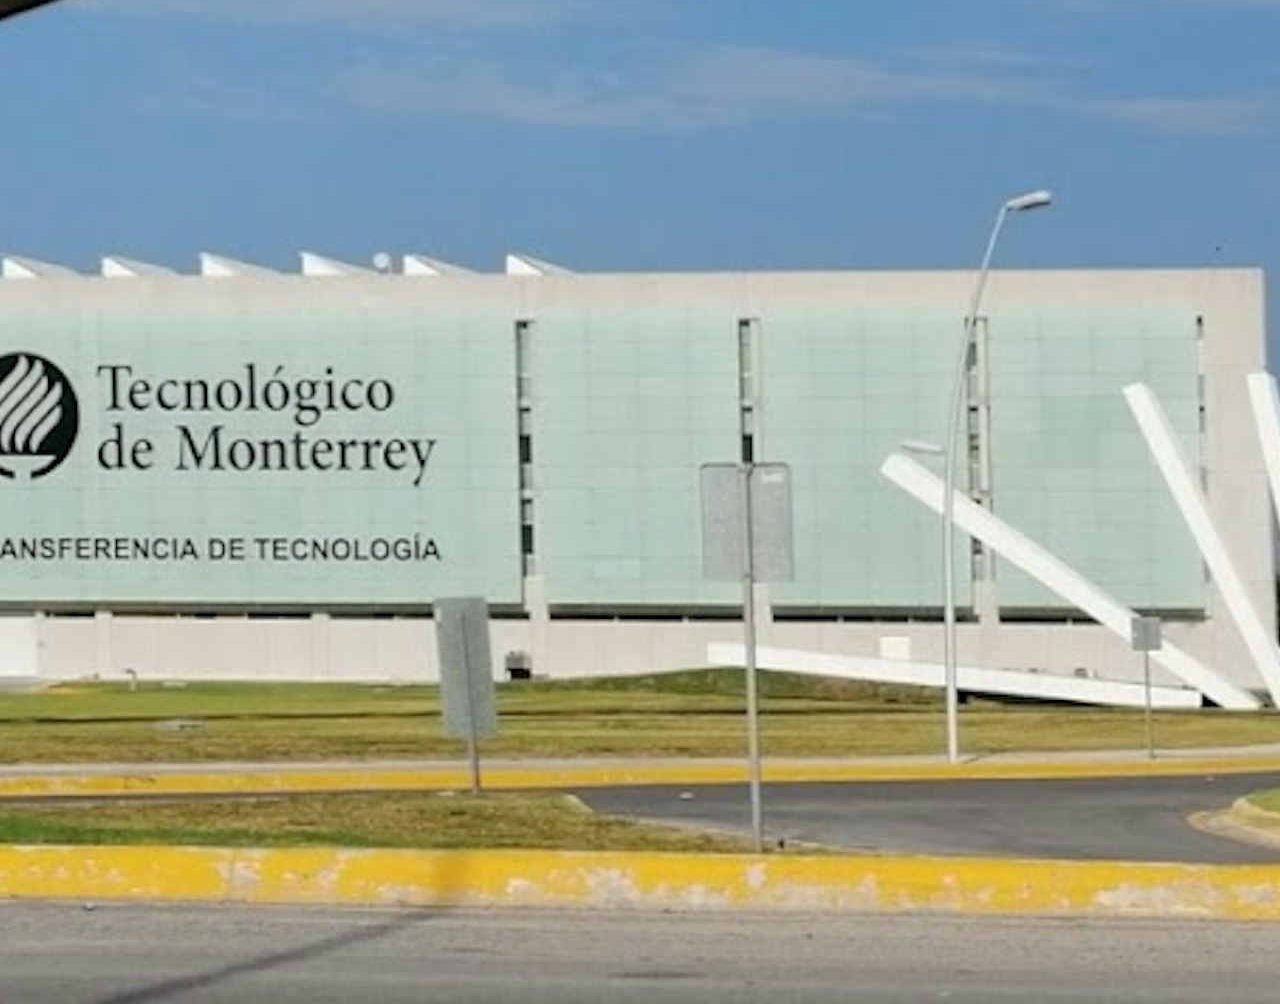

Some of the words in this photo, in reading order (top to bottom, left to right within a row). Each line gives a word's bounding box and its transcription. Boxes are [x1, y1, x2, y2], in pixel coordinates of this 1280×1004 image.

[96, 363, 395, 426] Tecnológico
[96, 422, 155, 471] de
[176, 424, 437, 487] Monterrey
[208, 537, 245, 561] DE
[253, 533, 441, 561] TECNOLOGÍA
